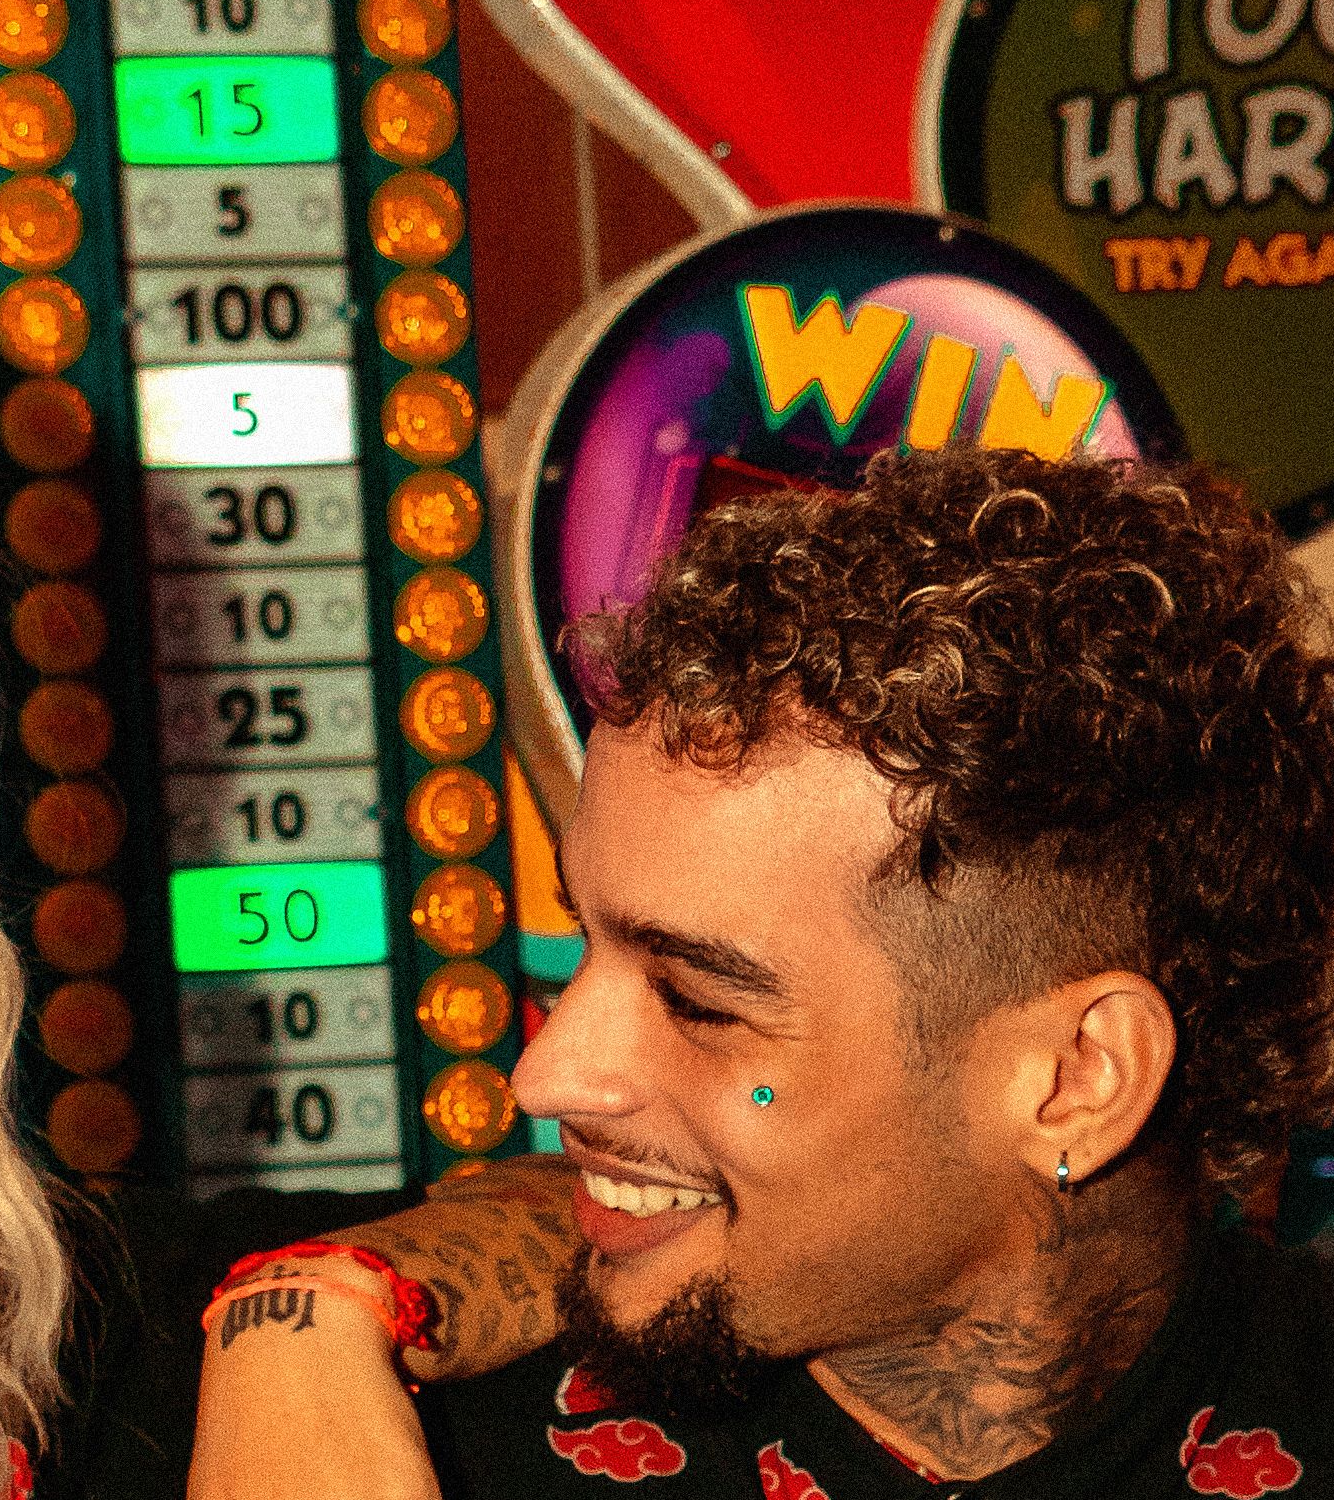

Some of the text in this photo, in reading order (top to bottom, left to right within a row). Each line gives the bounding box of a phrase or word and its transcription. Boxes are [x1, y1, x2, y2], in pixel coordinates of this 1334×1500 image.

[188, 82, 264, 138] 15
[216, 183, 251, 238] 5
[1104, 234, 1212, 291] TRY
[169, 281, 301, 345] 100
[737, 283, 1117, 462] WIN
[232, 393, 259, 436] 5
[205, 484, 297, 546] 30
[223, 588, 294, 642] 10
[218, 686, 310, 747] 25
[235, 790, 305, 843] 10
[237, 888, 319, 946] 50
[245, 991, 317, 1043] 10
[247, 1084, 334, 1147] 40
